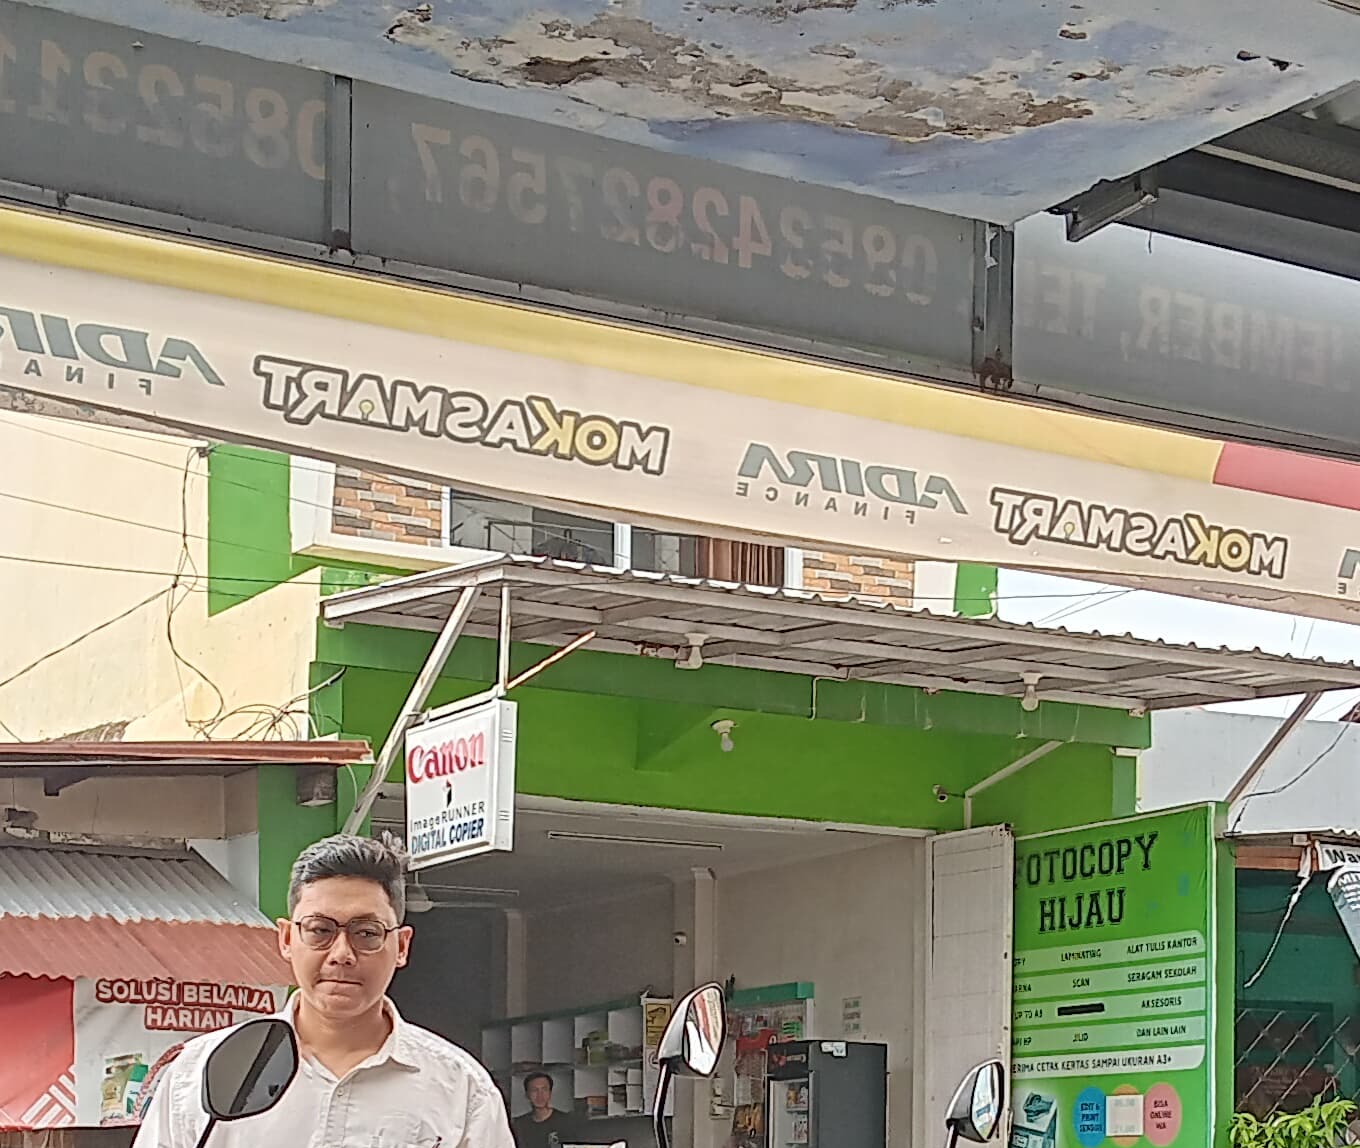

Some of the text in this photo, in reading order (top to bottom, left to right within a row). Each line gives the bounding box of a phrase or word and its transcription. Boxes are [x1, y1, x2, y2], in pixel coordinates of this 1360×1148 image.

[408, 731, 486, 784] Canon
[411, 818, 485, 855] DIGITAL COPIER
[1038, 887, 1125, 934] HIJAU
[1127, 942, 1143, 955] ALAT
[1146, 940, 1165, 951] TULIS
[1167, 937, 1197, 950] KANTOR
[1072, 977, 1091, 988] SCAN
[1127, 971, 1162, 983] SERAGAM
[1164, 965, 1197, 979] SEKOLAH
[96, 979, 275, 1012] SOLUSI BELANJA
[1141, 996, 1182, 1009] AKSESORIS
[145, 1006, 233, 1030] HARIAN
[1061, 1058, 1089, 1070] KERTAS
[1092, 1057, 1122, 1069] SAMPAI
[1123, 1055, 1154, 1067] UKURAN
